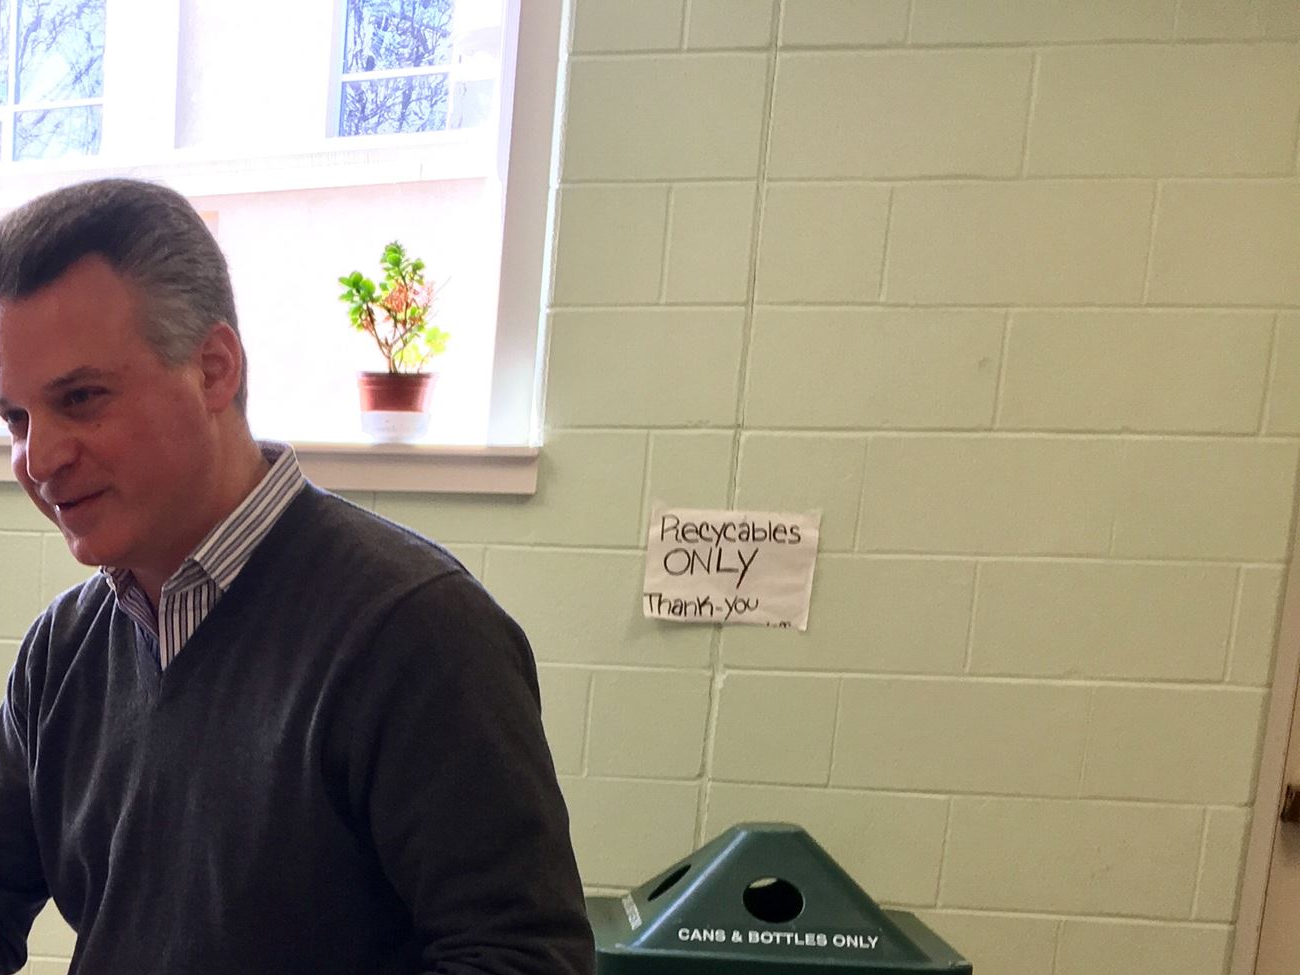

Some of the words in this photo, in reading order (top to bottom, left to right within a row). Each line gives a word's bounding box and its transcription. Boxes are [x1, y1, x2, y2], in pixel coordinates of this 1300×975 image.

[660, 513, 802, 547] Recycables
[663, 547, 759, 589] ONLY
[677, 927, 726, 942] CANS
[731, 930, 743, 943] &
[748, 930, 828, 946] BOTTLES
[832, 934, 879, 949] ONLY
